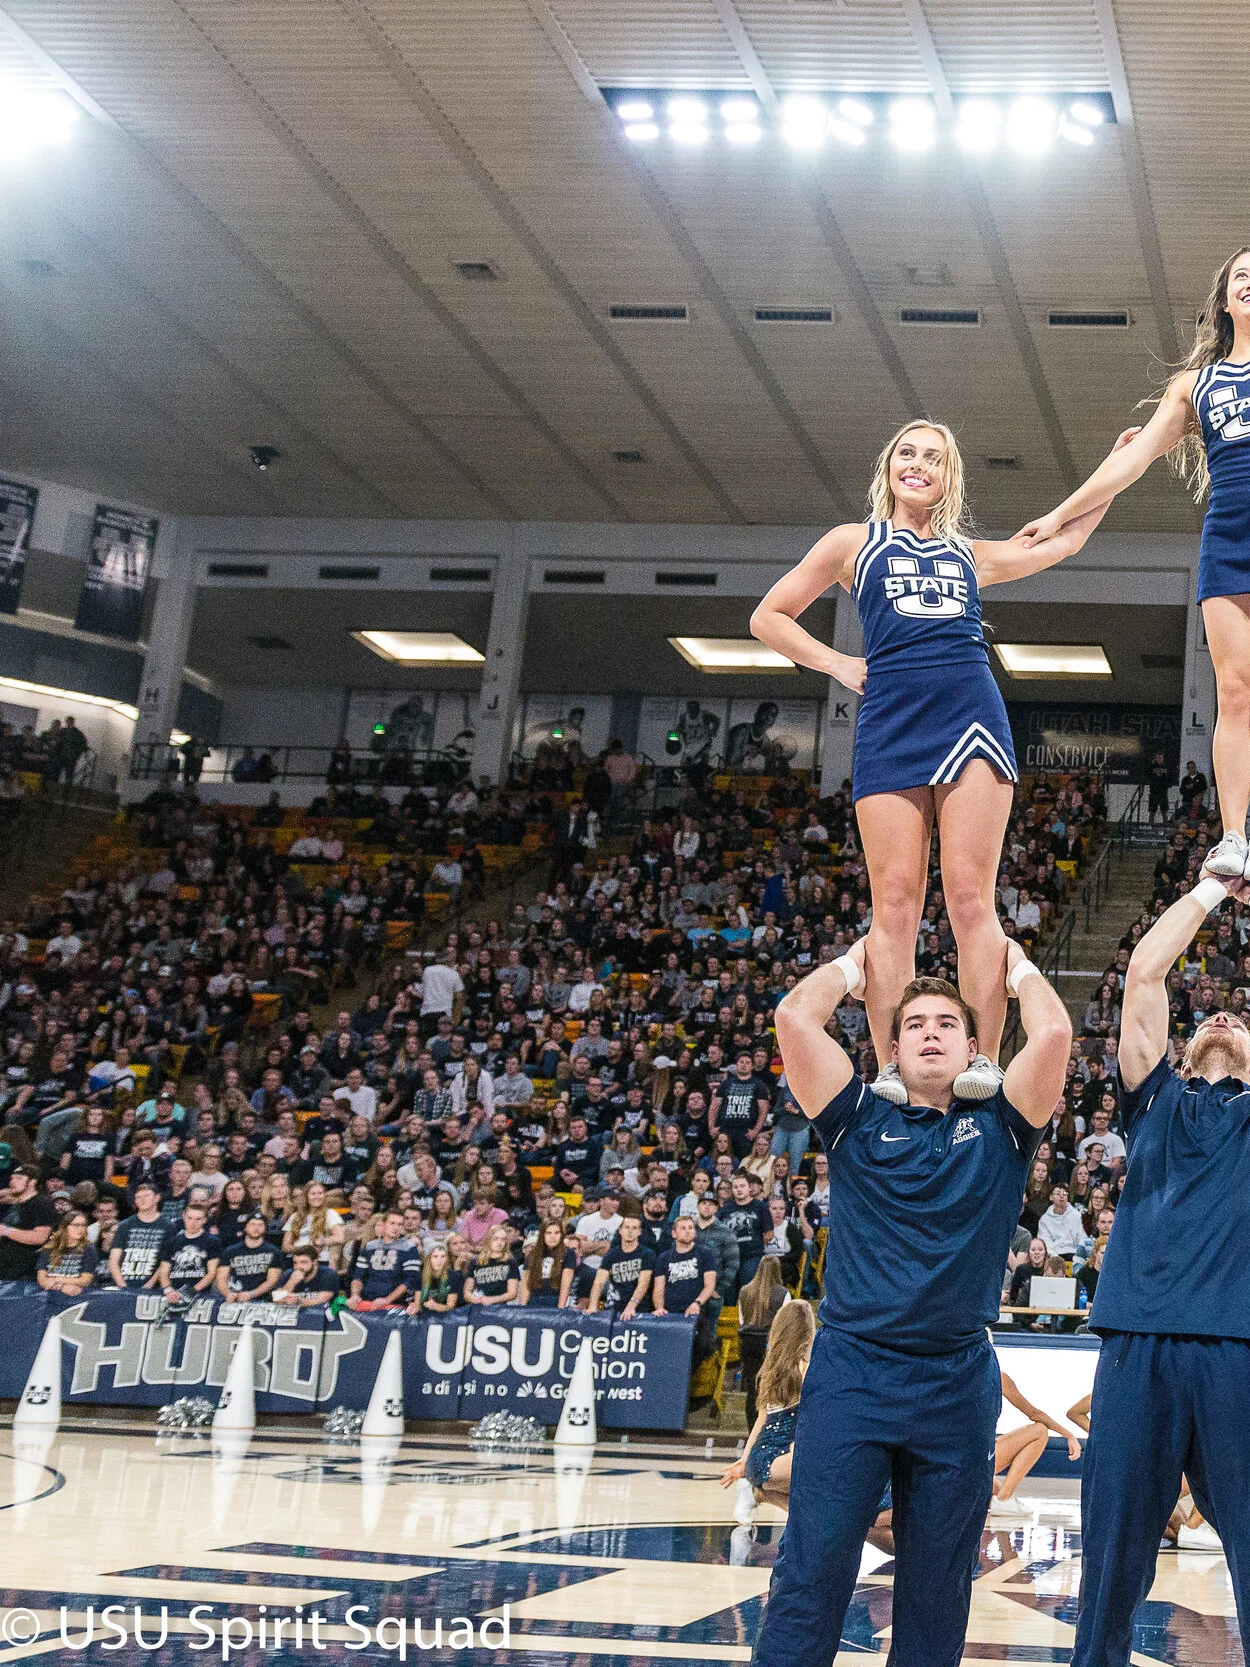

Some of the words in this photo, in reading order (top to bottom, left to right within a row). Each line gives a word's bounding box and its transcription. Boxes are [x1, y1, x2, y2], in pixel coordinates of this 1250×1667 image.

[884, 576, 969, 603] STATE
[487, 694, 499, 709] J
[835, 703, 849, 718] K
[1120, 713, 1182, 739] STA
[1192, 712, 1204, 727] L
[1026, 744, 1111, 769] CONSERVICE
[726, 1095, 753, 1105] TRUE
[726, 1104, 751, 1115] BLUE
[952, 1131, 982, 1145] AGGIES
[124, 1248, 159, 1263] TRUE
[122, 1262, 156, 1276] BLUE
[135, 1295, 215, 1323] UH
[217, 1302, 300, 1327] STATE
[51, 1301, 368, 1402] HURD
[425, 1324, 555, 1377] USU
